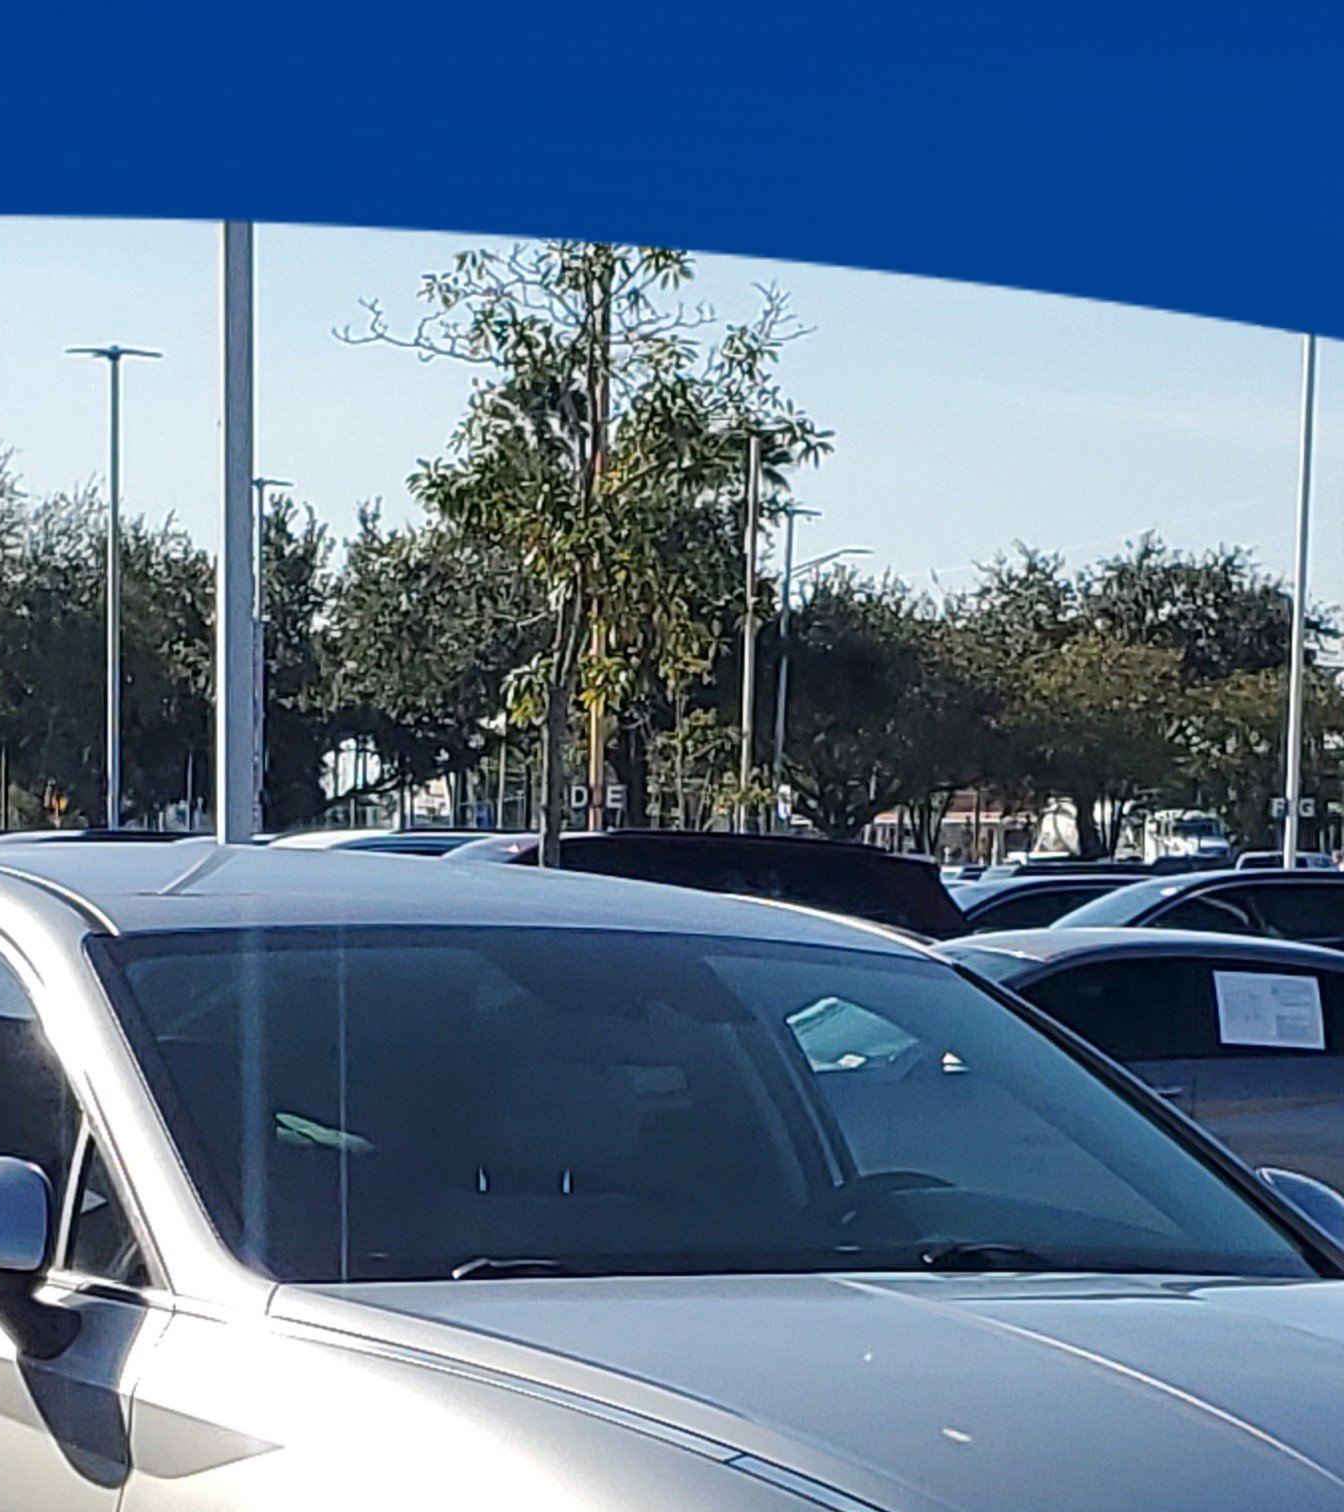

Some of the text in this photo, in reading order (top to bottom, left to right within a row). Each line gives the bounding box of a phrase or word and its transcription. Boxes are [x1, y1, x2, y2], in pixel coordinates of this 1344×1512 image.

[571, 785, 588, 808] D
[607, 785, 626, 808] E
[1299, 799, 1316, 817] G
